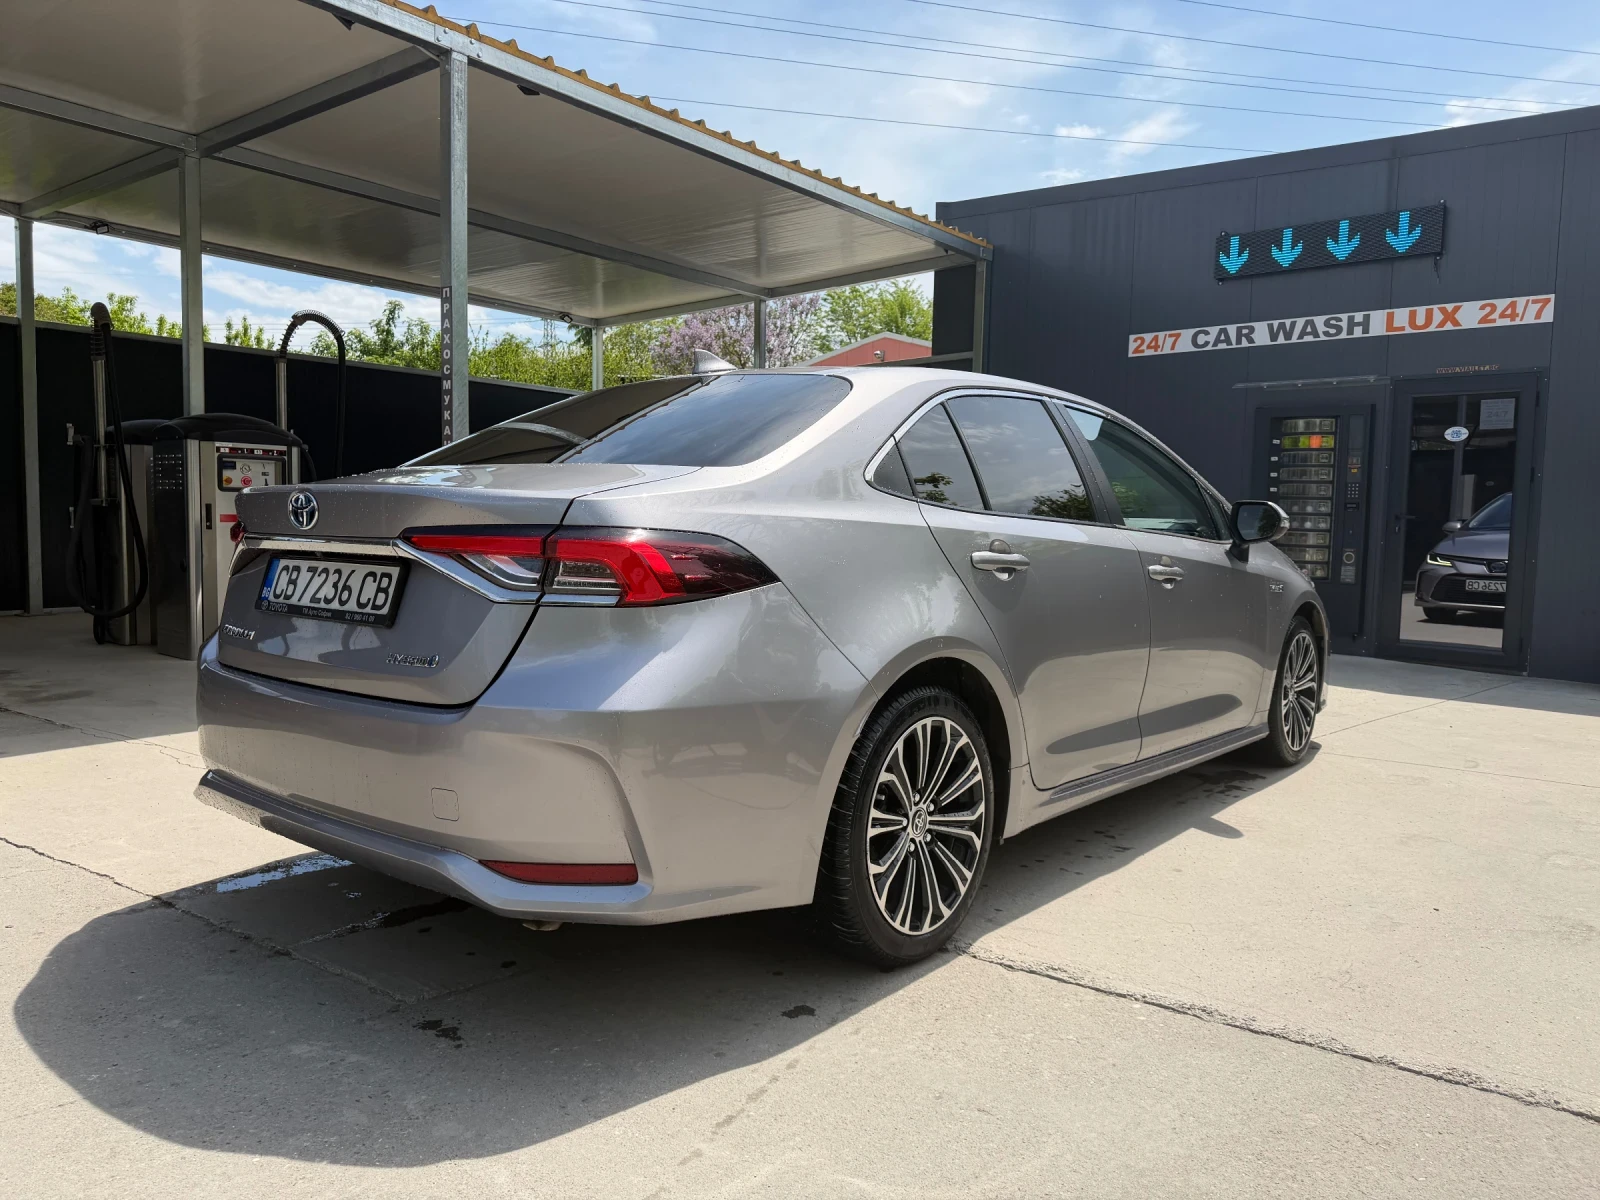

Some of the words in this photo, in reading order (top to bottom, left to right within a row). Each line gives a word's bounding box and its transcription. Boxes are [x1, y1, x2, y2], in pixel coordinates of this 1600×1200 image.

[1132, 333, 1182, 354] 24/7
[1191, 325, 1256, 349] CAR
[1267, 314, 1371, 343] WASH
[1385, 305, 1464, 333] LUX
[1477, 297, 1552, 325] 24/7
[262, 587, 271, 598] BG
[273, 564, 301, 600] CB
[298, 566, 356, 606] 7236
[356, 571, 392, 611] CB
[269, 602, 288, 613] TOYOTA
